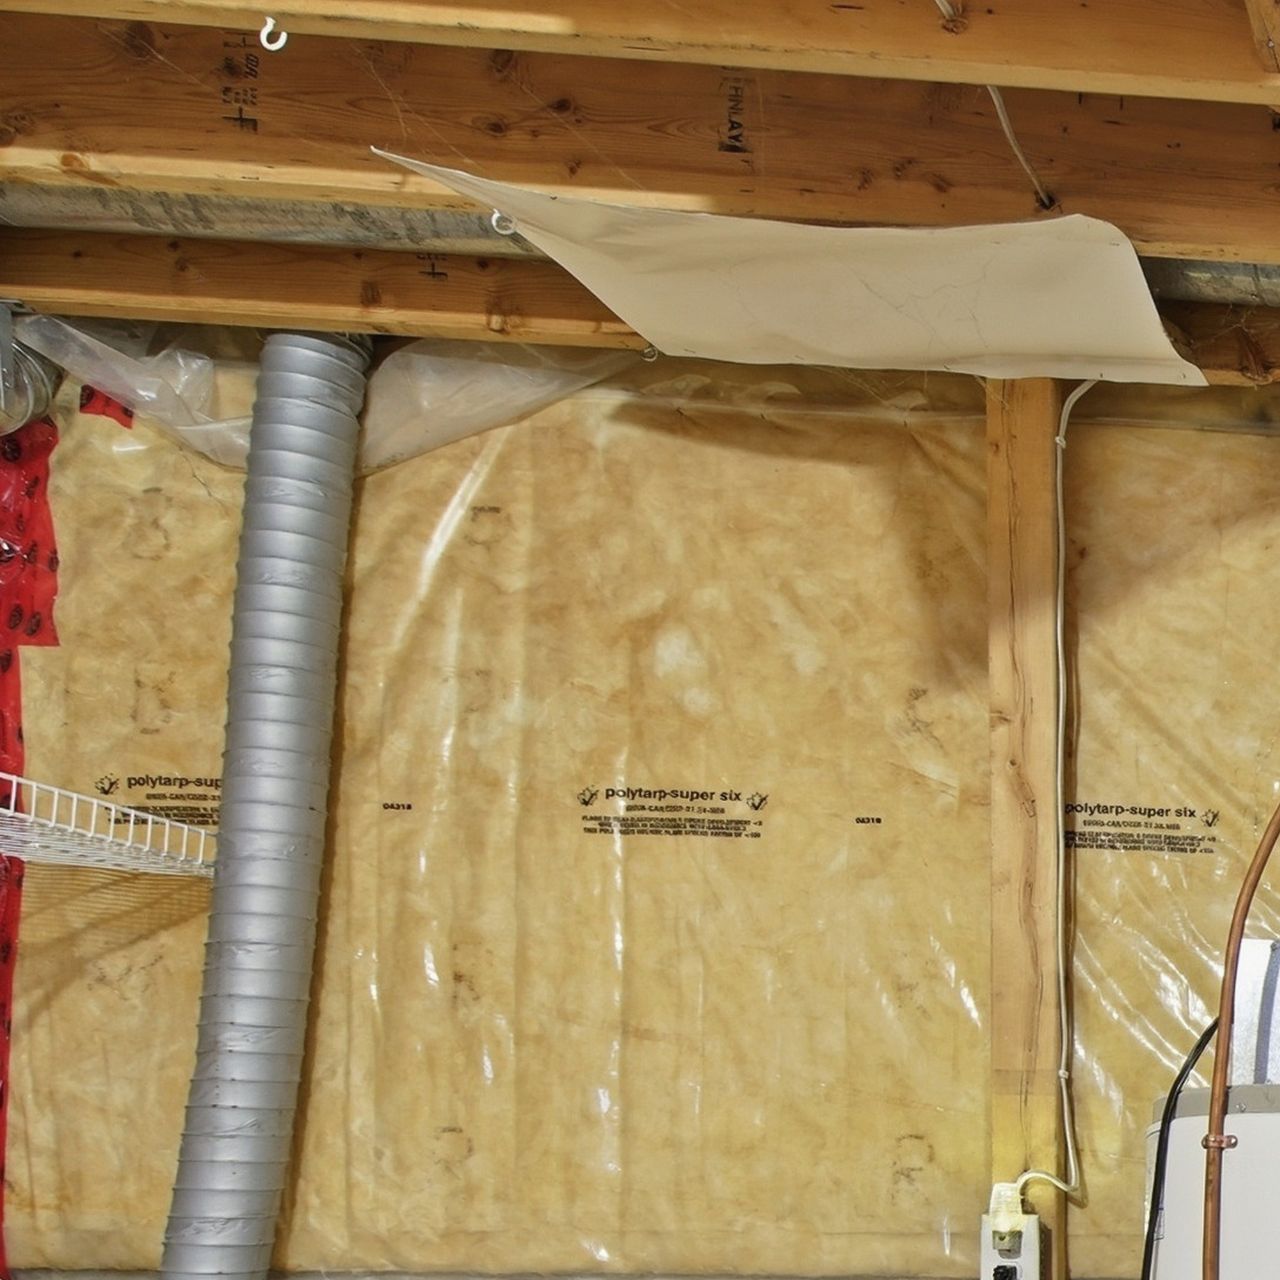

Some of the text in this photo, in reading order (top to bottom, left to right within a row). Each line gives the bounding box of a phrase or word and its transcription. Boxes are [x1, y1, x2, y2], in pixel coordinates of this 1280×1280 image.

[126, 774, 222, 790] polytarp-sup
[604, 786, 743, 803] polytarp-super six
[1064, 803, 1197, 819] polytarp-super six
